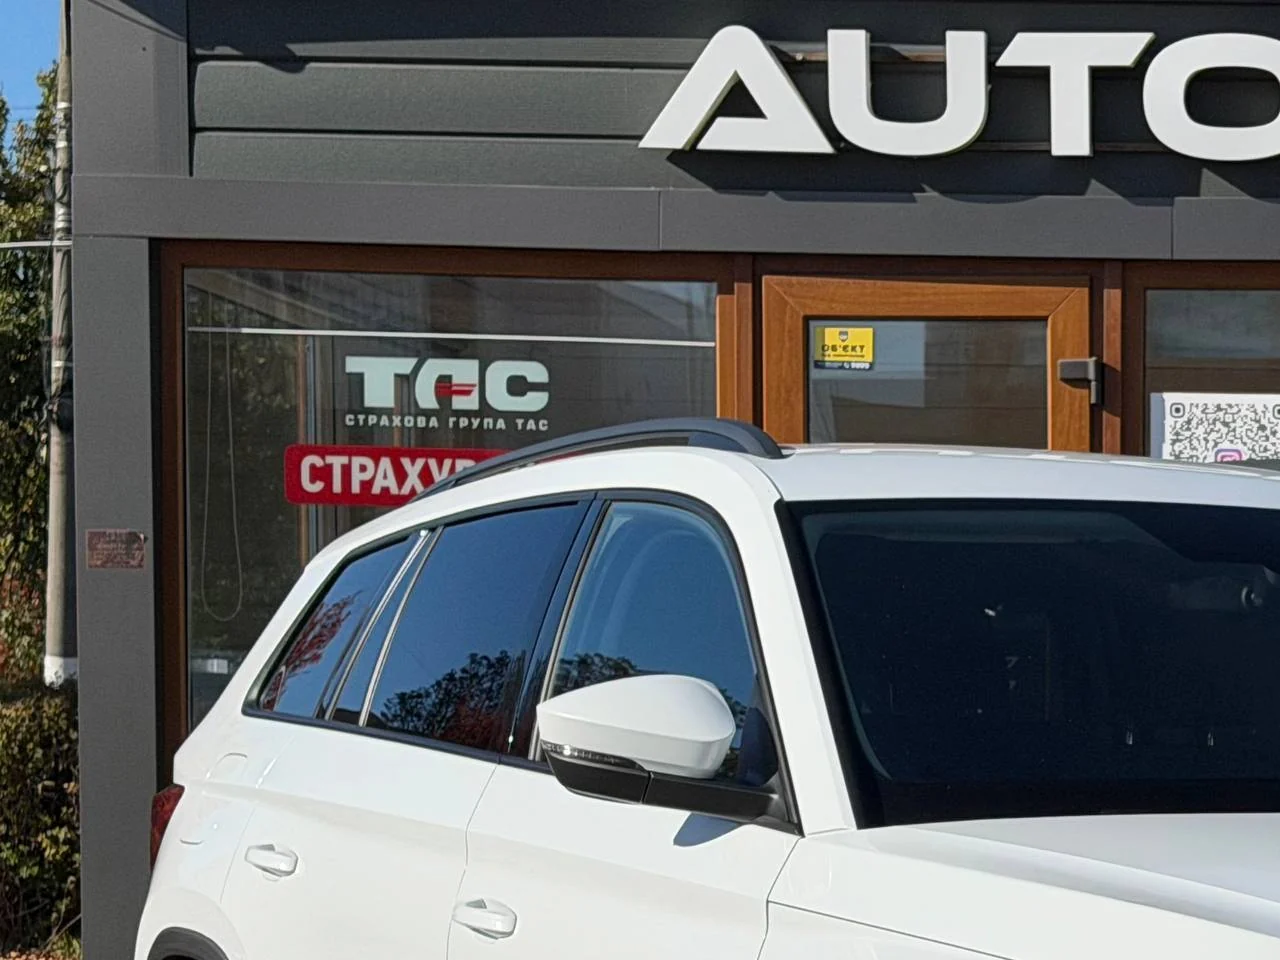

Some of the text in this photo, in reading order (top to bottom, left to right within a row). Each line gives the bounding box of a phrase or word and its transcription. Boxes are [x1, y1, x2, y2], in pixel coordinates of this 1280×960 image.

[345, 356, 549, 412] ТАС
[345, 414, 549, 431] СТРАХОВА ГРУПА ТАС
